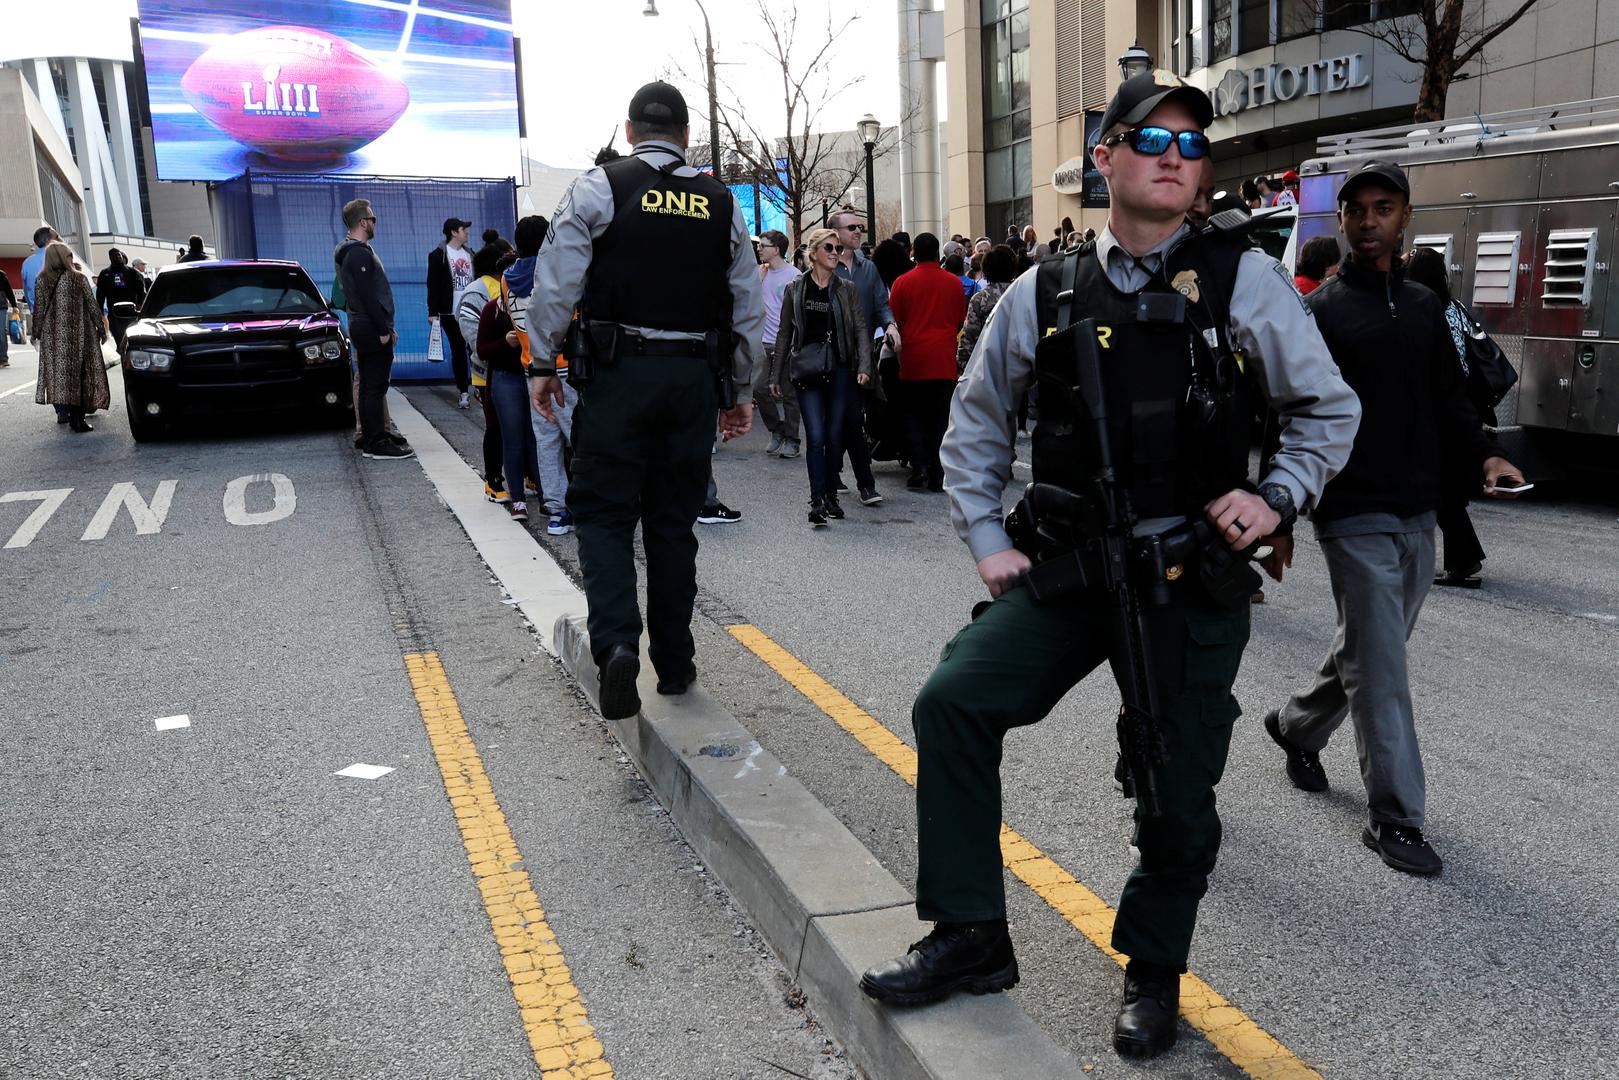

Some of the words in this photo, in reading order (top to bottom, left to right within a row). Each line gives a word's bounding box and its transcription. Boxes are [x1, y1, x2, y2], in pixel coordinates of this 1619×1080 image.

[1246, 53, 1370, 110] HOTEL
[641, 189, 710, 216] DNR
[642, 205, 658, 213] LAW
[659, 207, 710, 220] ENFORCEMENT
